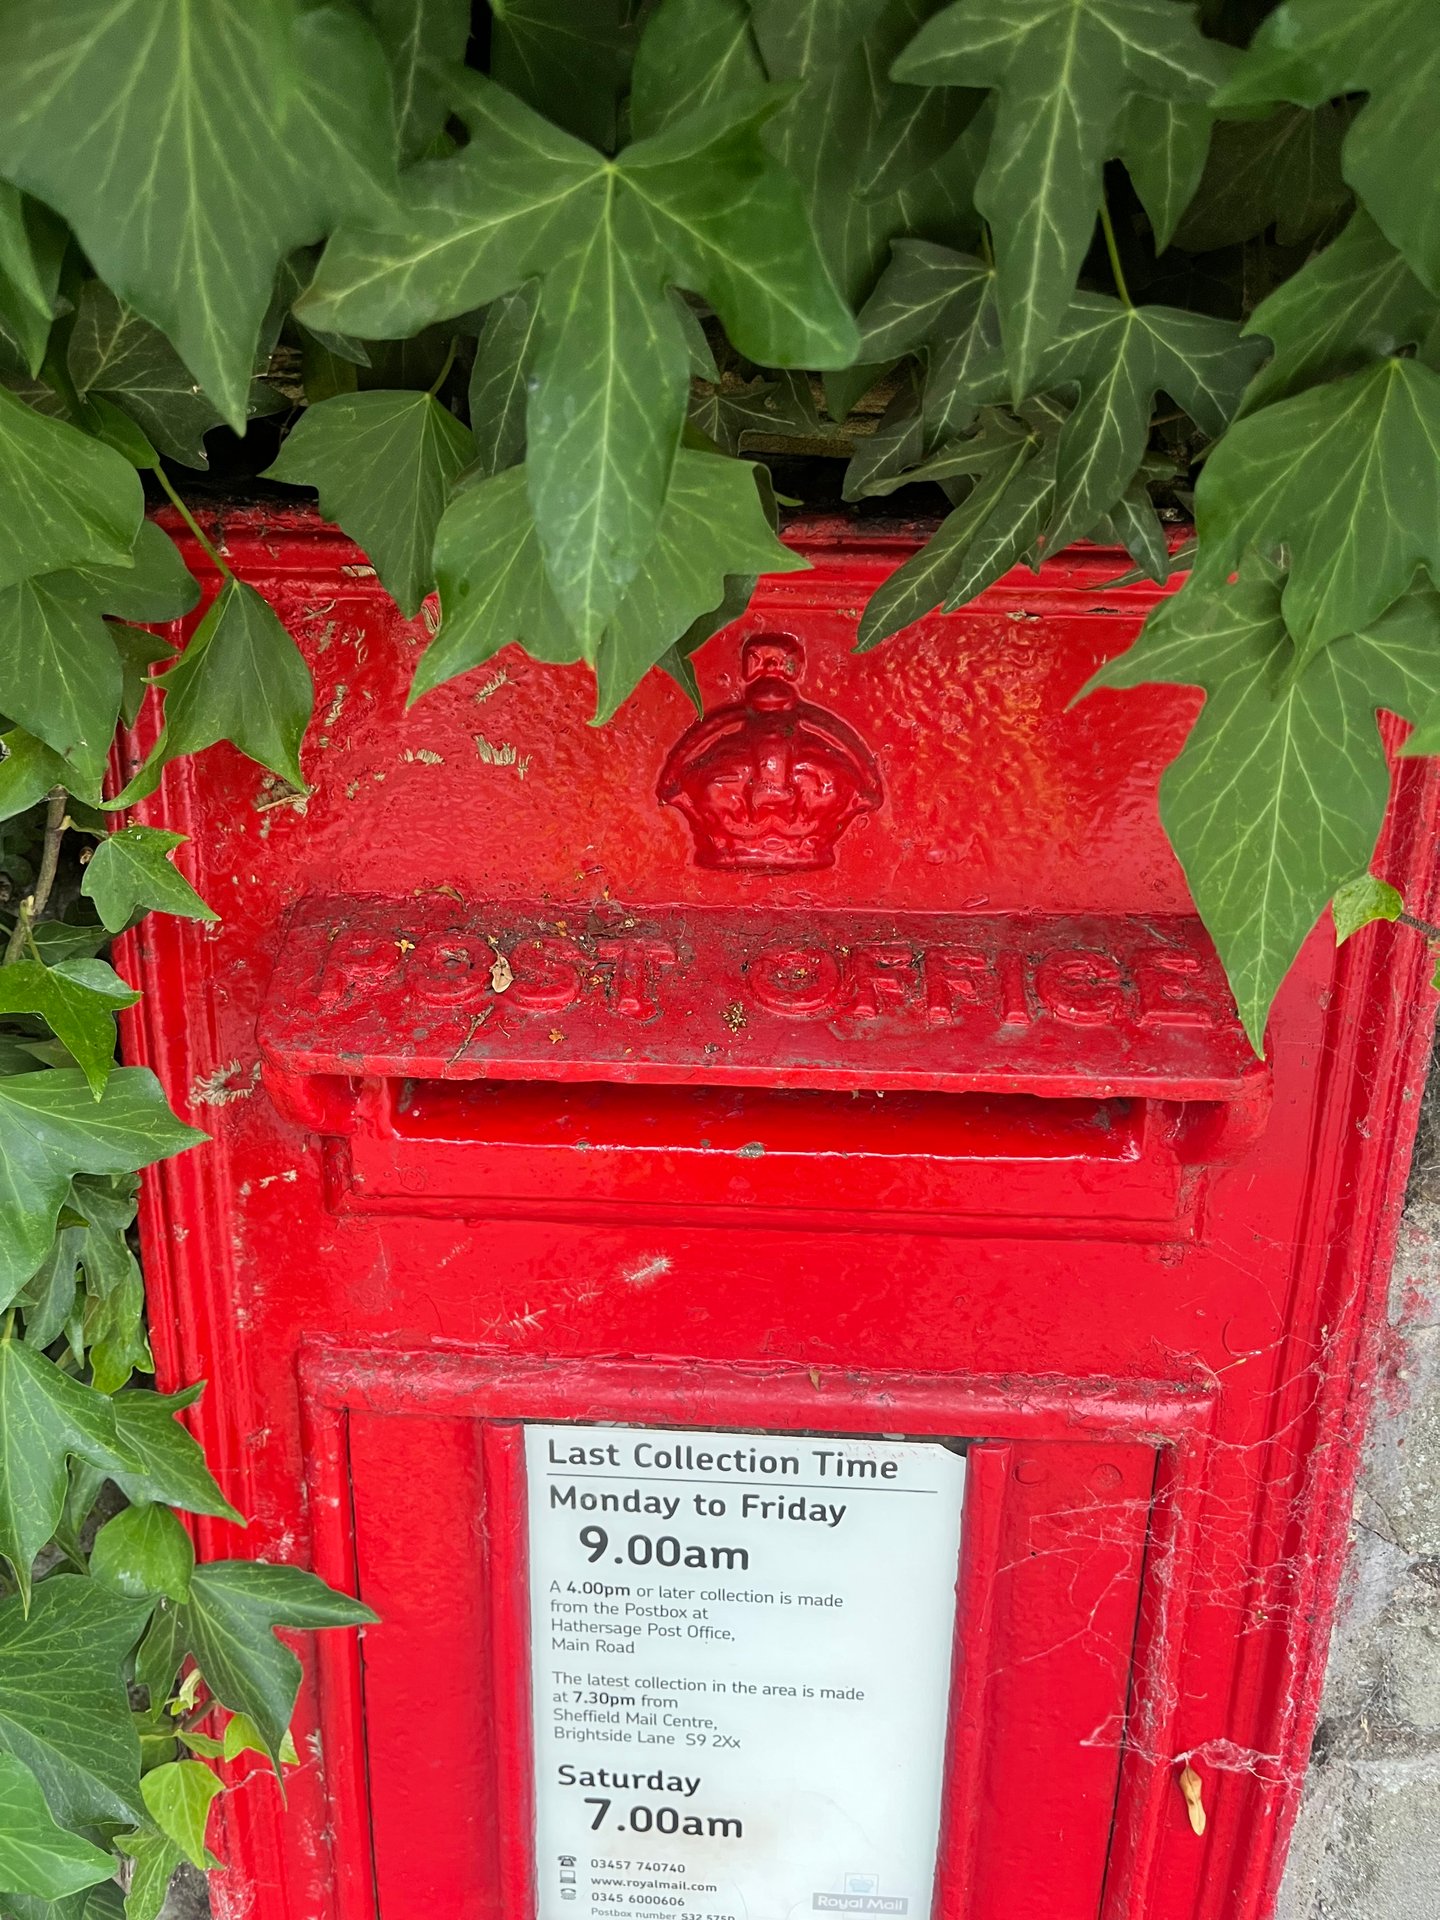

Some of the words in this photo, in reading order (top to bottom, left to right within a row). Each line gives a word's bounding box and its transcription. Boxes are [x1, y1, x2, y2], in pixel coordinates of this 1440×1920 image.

[318, 931, 676, 1020] POST
[745, 940, 1213, 1028] OFFICE
[549, 1439, 620, 1466] Last
[634, 1443, 799, 1474] Collection
[812, 1451, 898, 1479] Time
[551, 1485, 680, 1519] Monday
[692, 1493, 726, 1517] to
[743, 1494, 846, 1527] Friday
[580, 1526, 748, 1570] 9.00am
[549, 1579, 562, 1594] A
[566, 1580, 631, 1599] 4.00pm
[636, 1587, 655, 1598] or
[658, 1585, 696, 1600] later
[700, 1588, 774, 1604] collection
[780, 1590, 793, 1605] is
[797, 1593, 844, 1608] made
[550, 1598, 588, 1614] from
[593, 1601, 620, 1615] the
[625, 1602, 688, 1619] Postbox
[692, 1607, 709, 1620] at
[551, 1617, 642, 1638] Hathersage
[647, 1622, 682, 1638] Post
[687, 1624, 736, 1642] Office,
[551, 1636, 590, 1652] Main
[595, 1638, 635, 1654] Road
[551, 1670, 583, 1686] The
[587, 1673, 630, 1688] latest
[634, 1676, 707, 1692] collection
[712, 1679, 727, 1693] in
[732, 1680, 758, 1695] the
[762, 1685, 797, 1697] area
[802, 1681, 815, 1698] is
[820, 1687, 865, 1701] made
[552, 1691, 569, 1703] at
[572, 1690, 636, 1708] 7.30pm
[641, 1694, 679, 1709] from
[553, 1707, 620, 1724] Sheffield
[625, 1711, 657, 1726] Mail
[662, 1713, 718, 1731] Centre,
[554, 1725, 632, 1743] Brightside
[637, 1730, 676, 1745] Lane
[685, 1732, 707, 1747] S9
[559, 1765, 700, 1797] Saturday
[584, 1798, 742, 1838] 7.00am
[590, 1858, 632, 1871] 03457
[636, 1861, 686, 1874] 740740
[590, 1877, 718, 1893] www.royalmail.com
[591, 1892, 624, 1903] 0345
[628, 1894, 685, 1907] 6000606
[817, 1894, 864, 1911] Royal
[866, 1899, 904, 1912] Mail
[591, 1907, 632, 1918] Postbox
[635, 1911, 677, 1920] number
